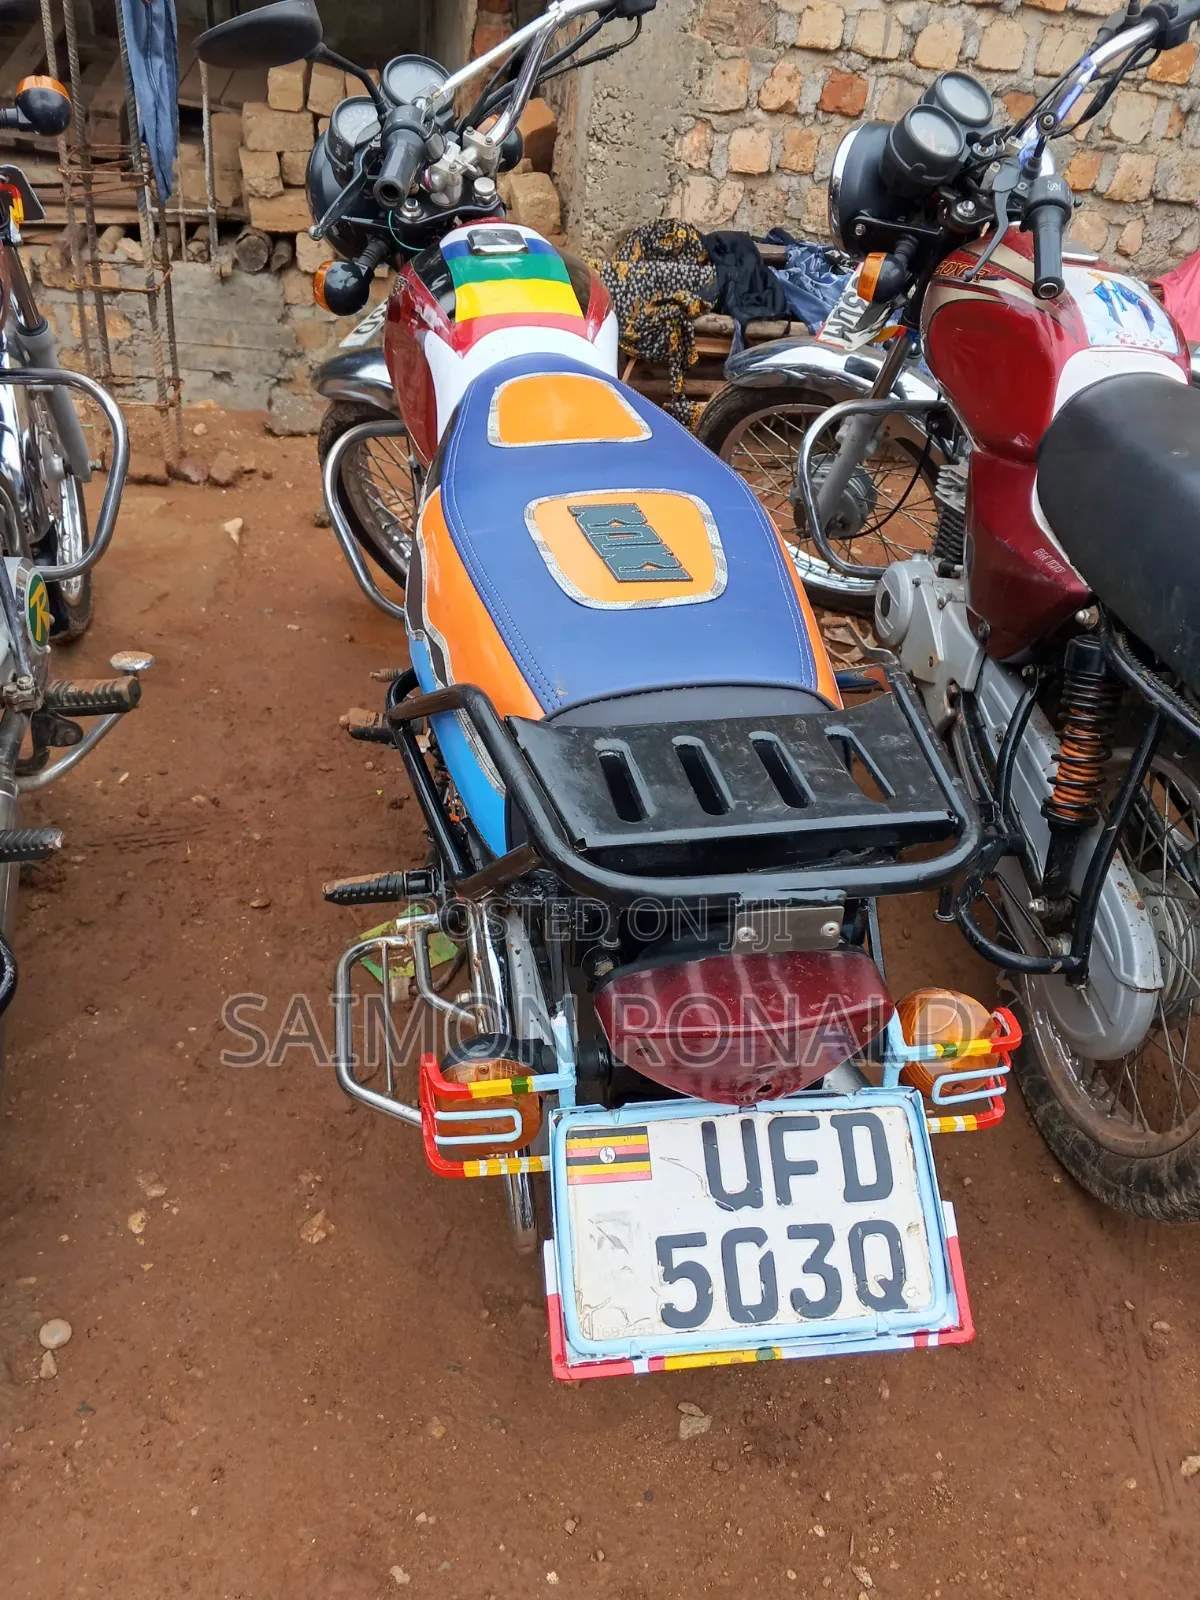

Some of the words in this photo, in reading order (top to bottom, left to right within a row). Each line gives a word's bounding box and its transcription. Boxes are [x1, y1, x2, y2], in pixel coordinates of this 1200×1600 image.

[567, 502, 694, 583] KAKI
[701, 1112, 894, 1212] UFD
[655, 1220, 908, 1329] 503Q
